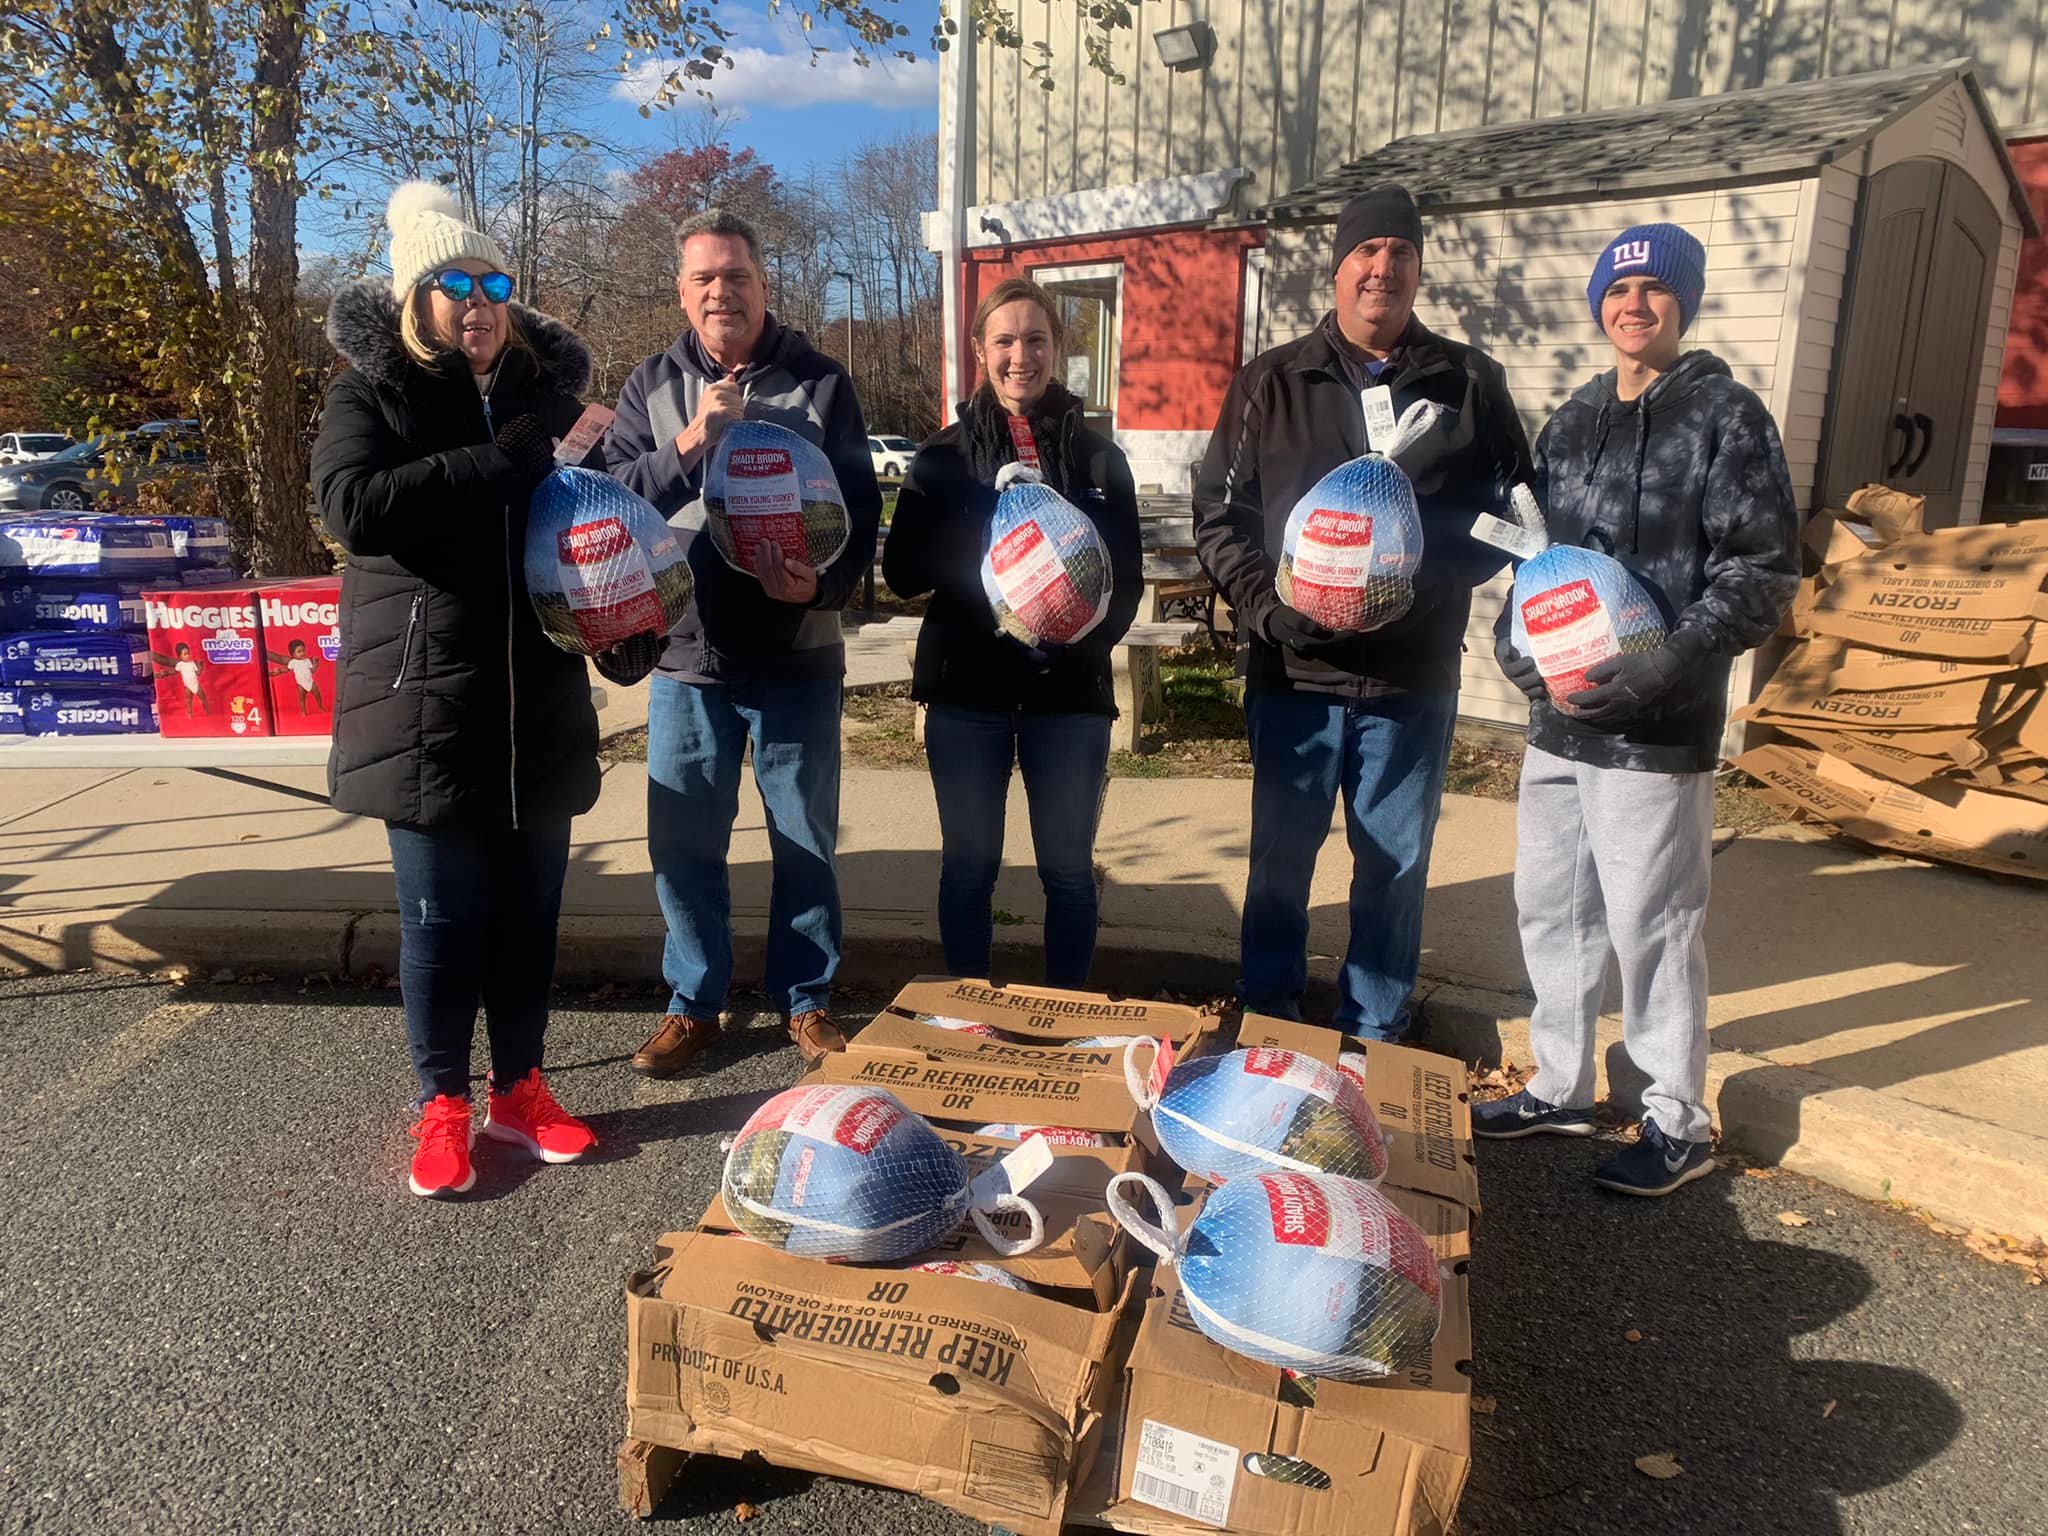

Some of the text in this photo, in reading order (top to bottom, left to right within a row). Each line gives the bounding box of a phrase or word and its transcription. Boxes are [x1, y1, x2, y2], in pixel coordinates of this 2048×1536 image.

[757, 453, 786, 464] BROOK
[1338, 518, 1367, 534] BROOK
[1911, 578, 1931, 588] BOX
[1947, 579, 1991, 589] DIRECTED
[1870, 592, 1962, 611] FROZEN
[203, 640, 254, 649] movers
[1899, 630, 1921, 643] OR
[7, 646, 18, 660] 3
[31, 697, 41, 711] 3
[1811, 700, 1902, 718] FROZEN
[247, 707, 262, 726] 4
[1765, 770, 1838, 811] FROZEN
[955, 984, 1147, 1018] KEEP REFRIGERATED
[1027, 1015, 1056, 1028] OR
[932, 1048, 998, 1064] DIRECTED
[976, 1043, 1113, 1065] FROZEN
[861, 1061, 1081, 1095] KEEP REFRIGERATED
[941, 1093, 974, 1109] OR
[1380, 1101, 1408, 1120] OR
[1424, 1070, 1456, 1171] KEEP REFRIGERATED
[1283, 1197, 1305, 1234] SHADY
[736, 1281, 794, 1304] BELOW)
[867, 1281, 909, 1304] OR
[798, 1297, 821, 1309] OR
[855, 1306, 876, 1317] OF
[728, 1296, 1016, 1387] KEEP REFRIGERATED
[723, 1359, 743, 1381] OF
[745, 1365, 788, 1395] U.S.A.
